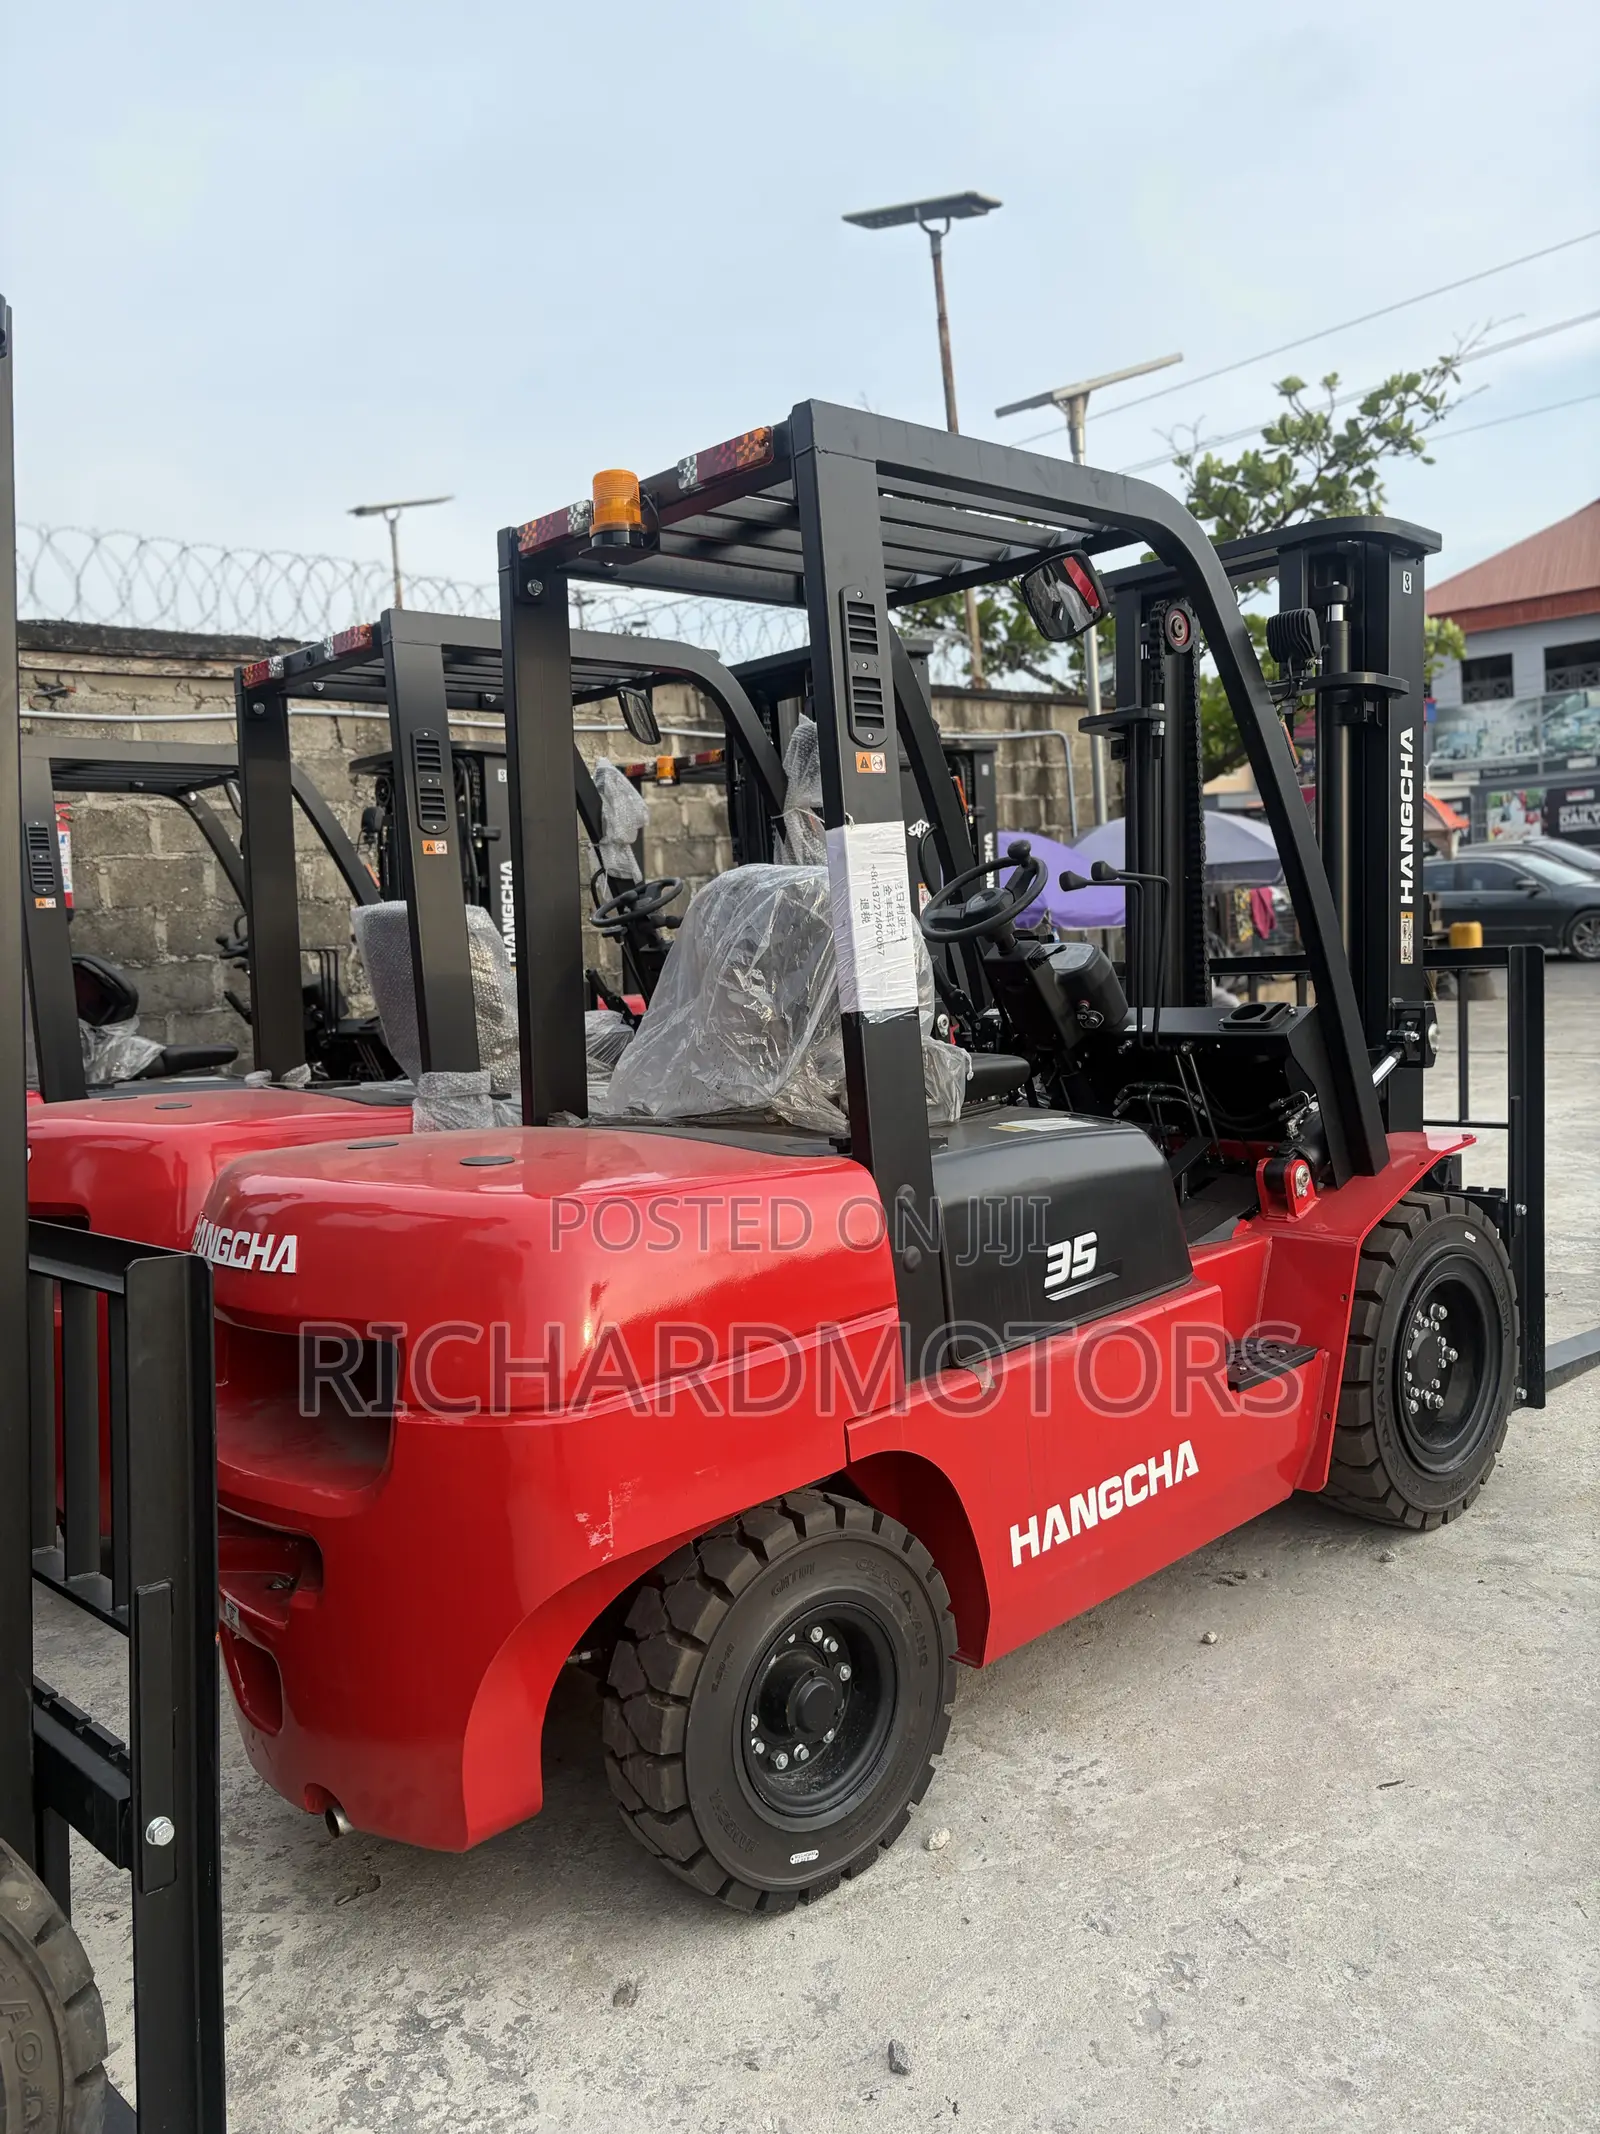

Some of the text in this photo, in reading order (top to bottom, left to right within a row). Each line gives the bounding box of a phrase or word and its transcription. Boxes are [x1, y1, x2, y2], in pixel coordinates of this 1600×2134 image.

[1400, 727, 1414, 904] HANGCHA
[191, 1211, 298, 1274] HANGCHA
[1043, 1230, 1097, 1289] 35
[1009, 1439, 1200, 1568] HANGCHA
